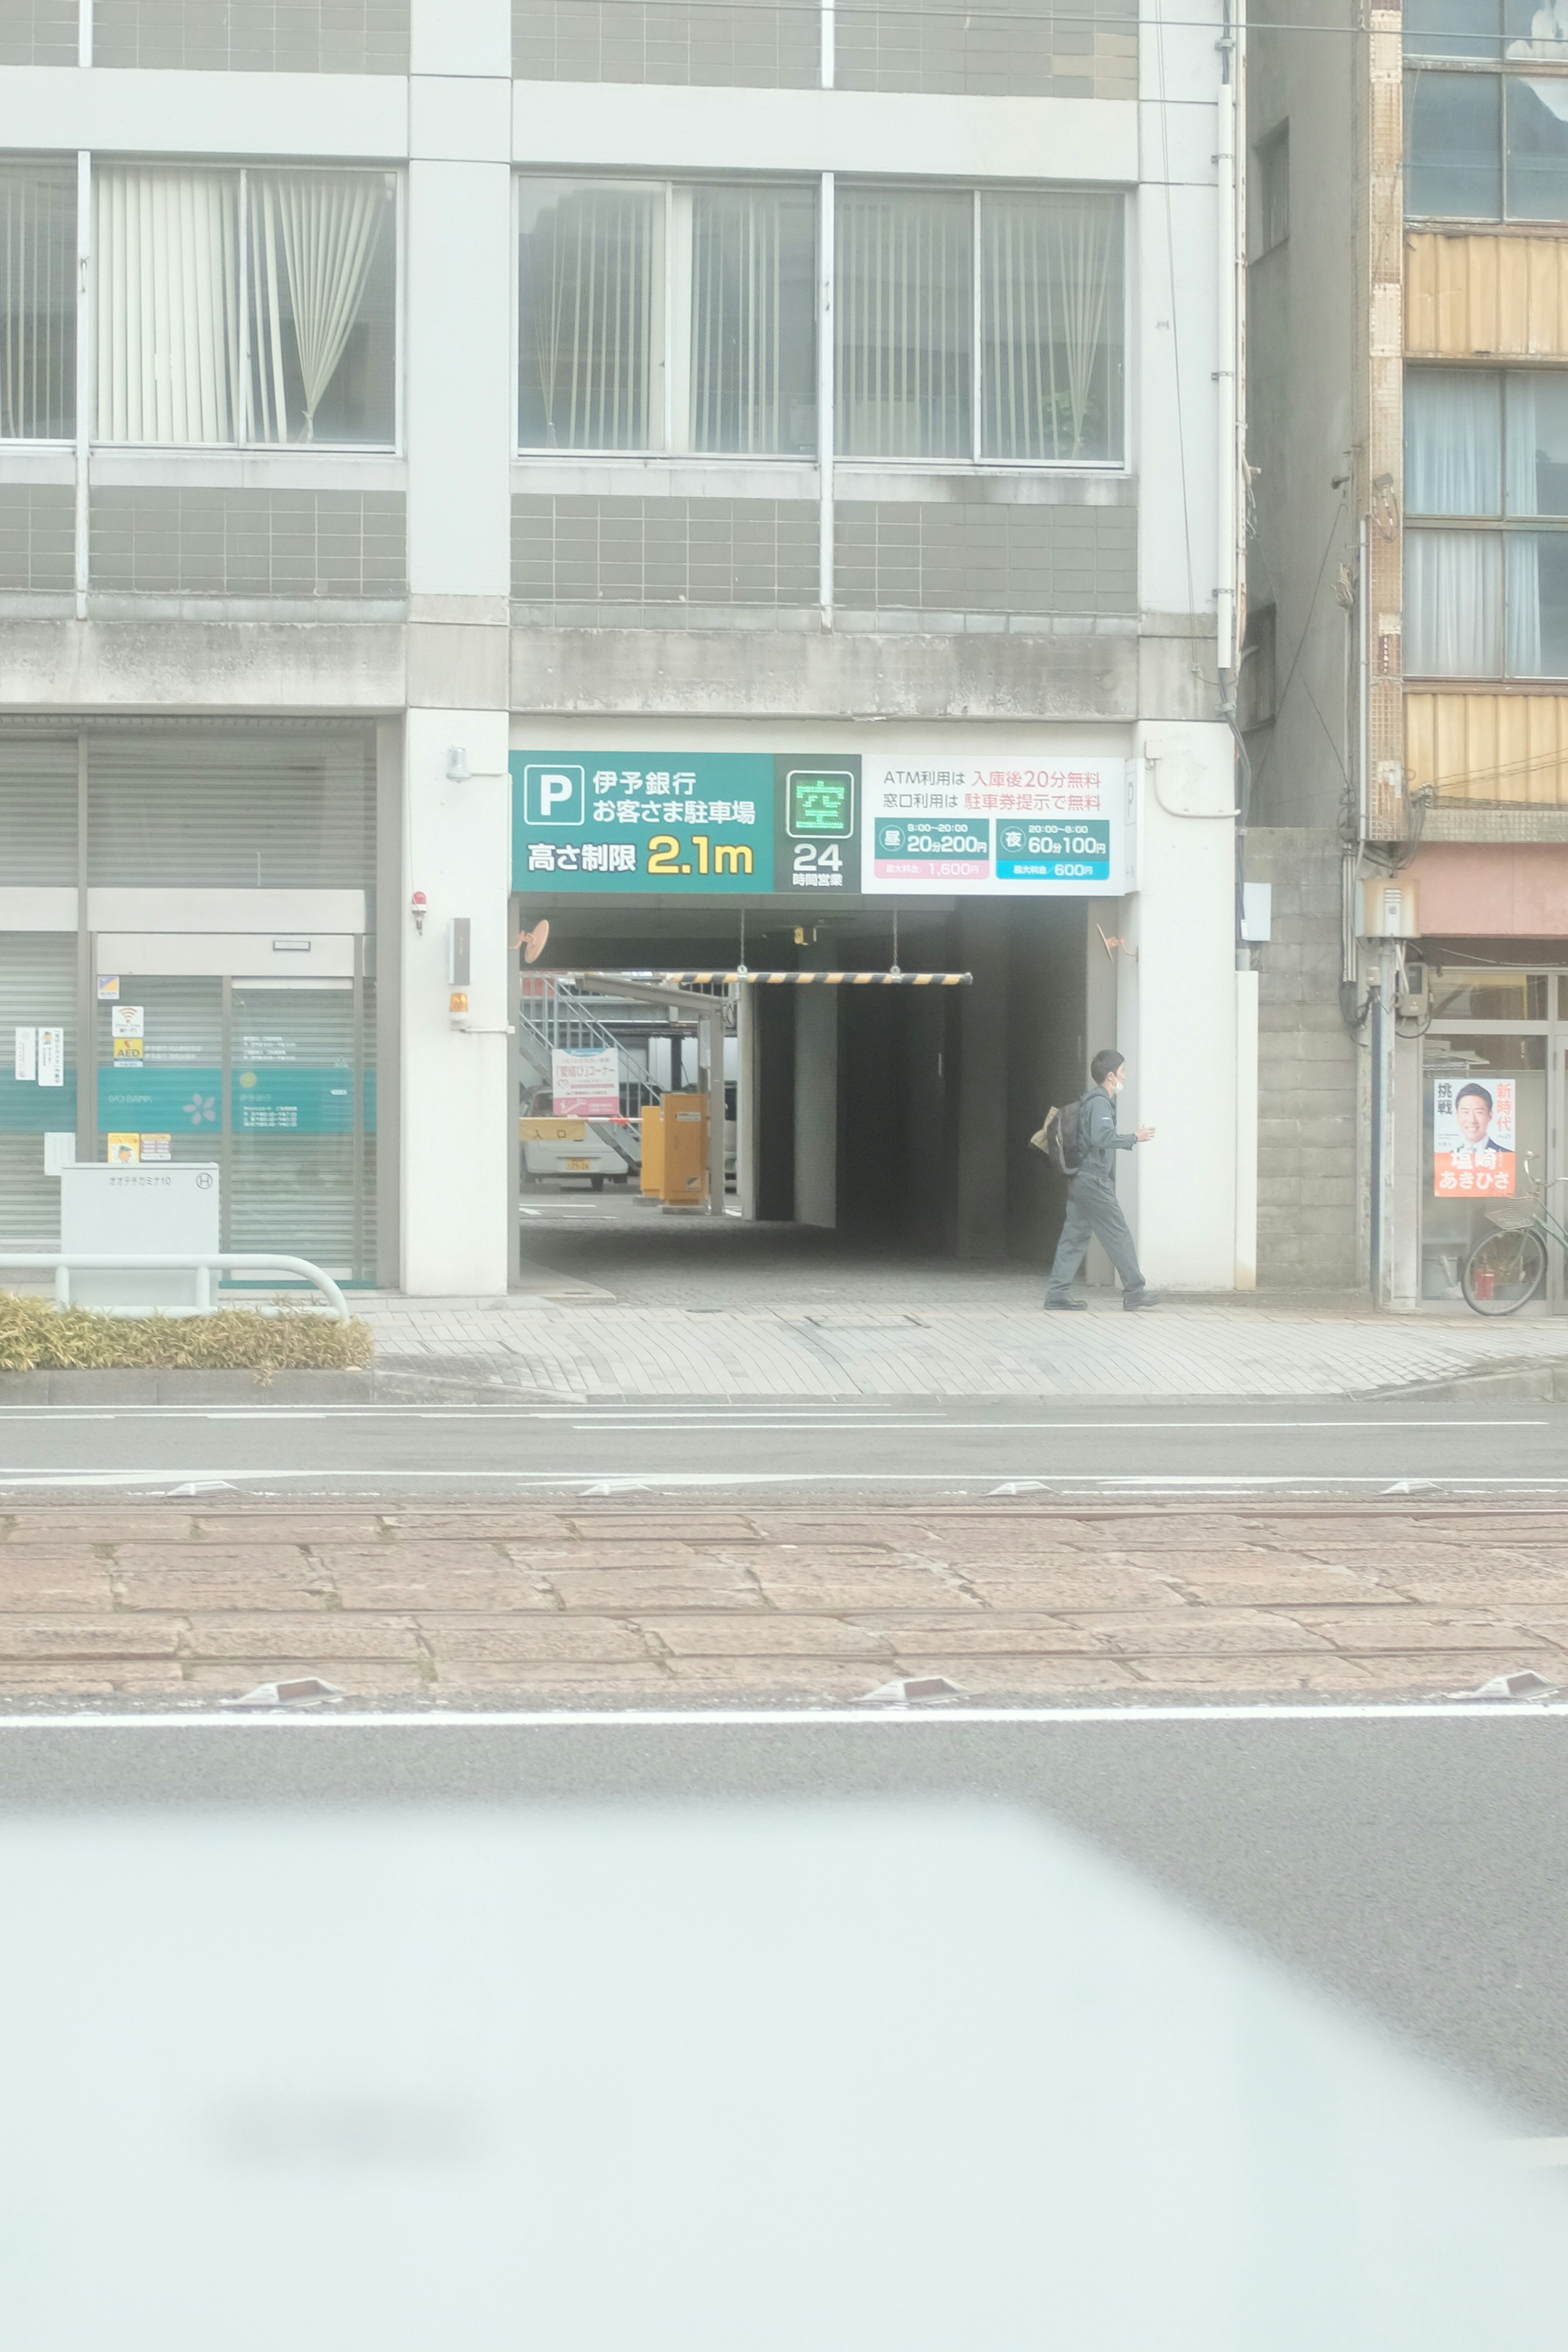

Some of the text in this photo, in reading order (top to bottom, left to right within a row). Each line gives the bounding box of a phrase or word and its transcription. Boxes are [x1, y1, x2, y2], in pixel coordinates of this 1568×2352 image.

[593, 770, 697, 795] 伊予銀行
[884, 770, 1100, 789] ATM利用は 入庫後20分無料
[541, 774, 572, 816] P
[796, 780, 844, 829] 空
[883, 793, 1100, 811] 窓口利用は 駐車券提示で無料
[593, 799, 756, 825] お客さま駐車場
[884, 830, 900, 846] 昼
[907, 835, 987, 853] 20分200円
[1005, 831, 1022, 847] 夜
[1028, 836, 1106, 854] 60分100円
[527, 835, 753, 874] 高さ制限 2.1m
[793, 843, 843, 872] 24
[792, 873, 843, 887] 時間営業
[117, 1049, 140, 1058] AED
[1437, 1083, 1453, 1115] 挑戦
[1451, 1147, 1497, 1170] 塩崎
[1439, 1170, 1509, 1190] あきひさ
